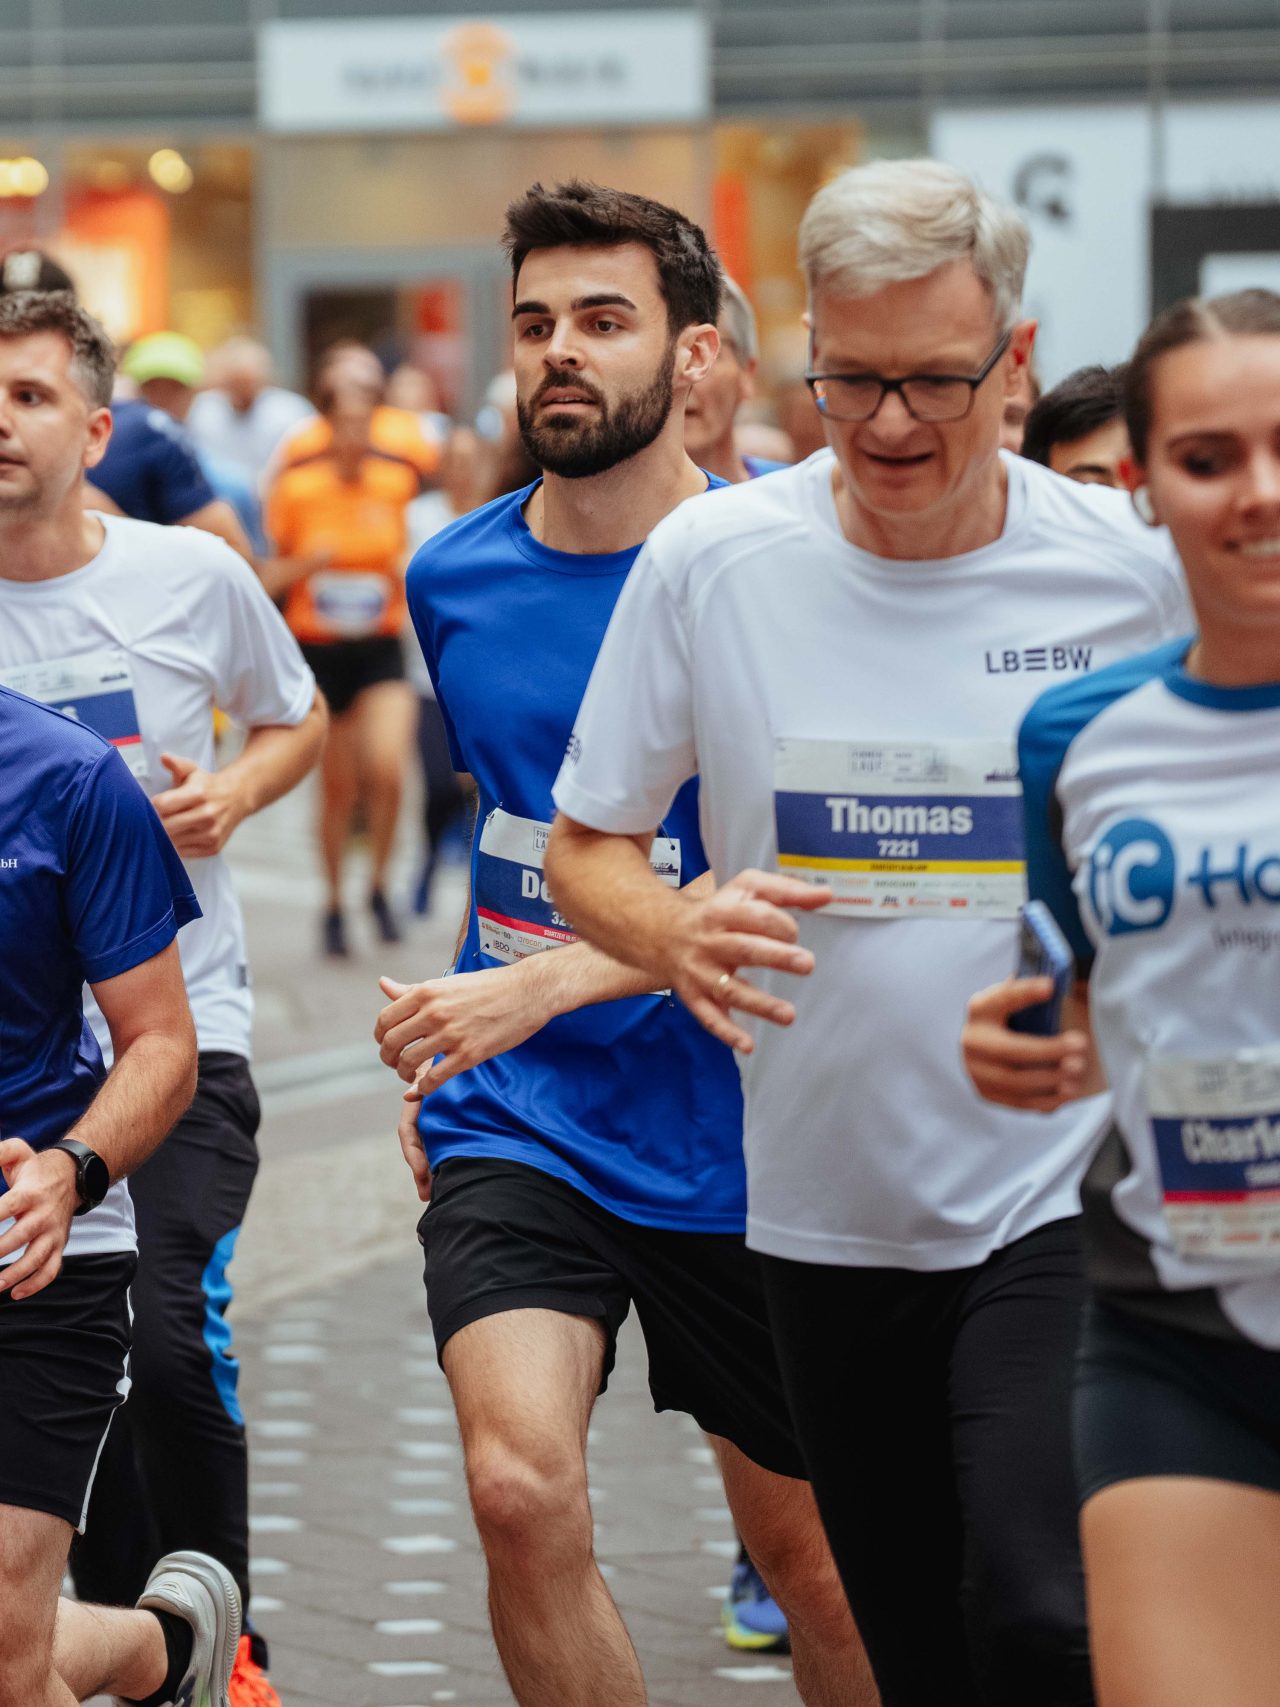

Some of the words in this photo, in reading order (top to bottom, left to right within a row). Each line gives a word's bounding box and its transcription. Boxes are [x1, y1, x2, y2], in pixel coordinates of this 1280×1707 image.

[825, 797, 973, 834] Thomas
[877, 838, 919, 858] 7221
[1180, 1117, 1280, 1165] Charl
